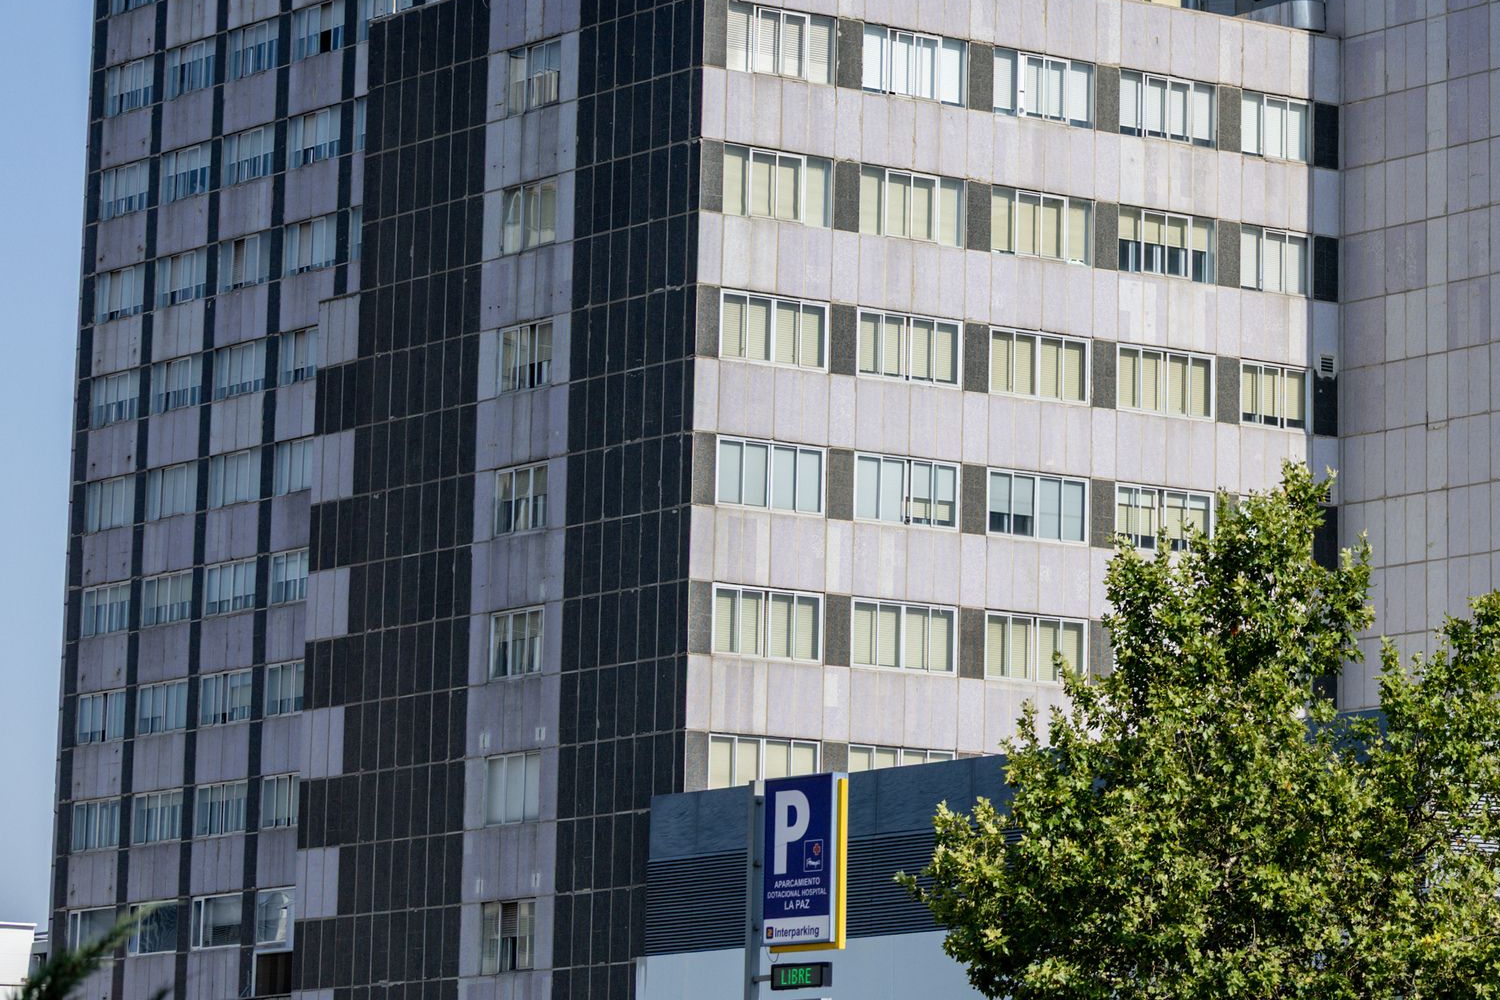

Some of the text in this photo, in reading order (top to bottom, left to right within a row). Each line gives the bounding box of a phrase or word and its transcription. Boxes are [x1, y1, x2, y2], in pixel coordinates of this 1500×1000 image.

[773, 789, 811, 875] P
[774, 877, 821, 889] APARCAMIENTO
[767, 888, 827, 899] DOTACIONAL HOSPITAL
[784, 899, 810, 910] LA PAZ
[774, 925, 820, 939] Interparking
[781, 967, 812, 985] LIBRE
